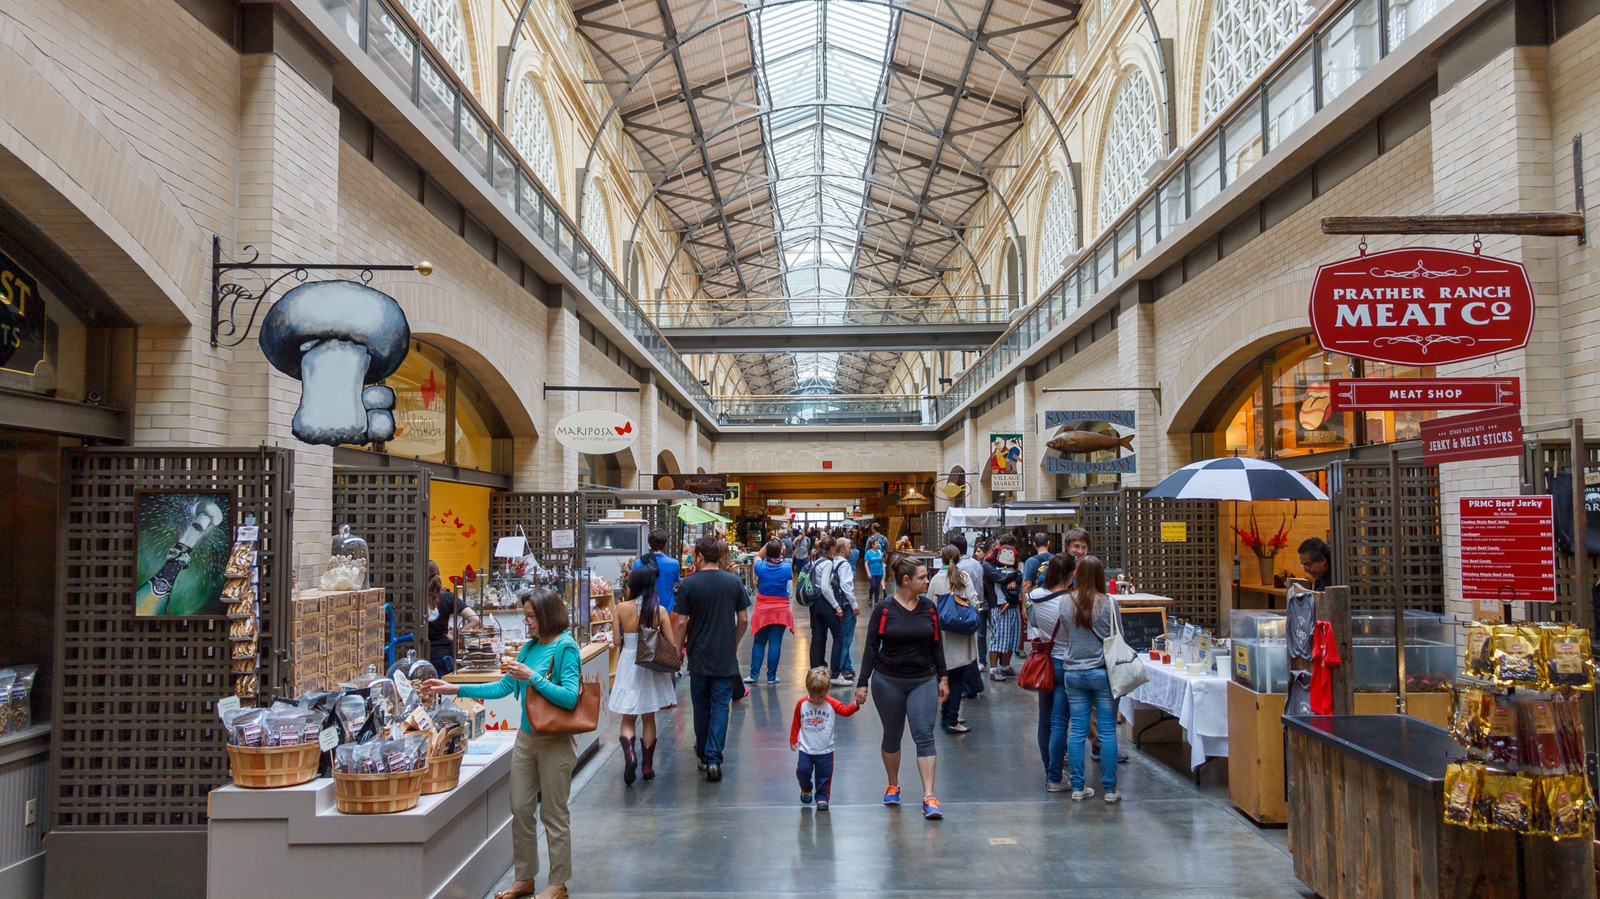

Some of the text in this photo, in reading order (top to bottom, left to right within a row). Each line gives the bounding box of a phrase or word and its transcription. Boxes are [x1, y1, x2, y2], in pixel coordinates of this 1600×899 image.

[1333, 286, 1511, 300] PRATHER RANCH
[1334, 303, 1452, 327] MEAT
[1389, 389, 1463, 399] MEAT SHOP
[1046, 410, 1135, 427] SAN FRANCISCO
[556, 427, 614, 436] MARIPOSA
[1449, 428, 1462, 436] OTHER
[1429, 431, 1513, 452] JERKY & MEAT STICKS
[1048, 455, 1135, 473] FISH COMPANY
[1517, 500, 1542, 508] Jerky
